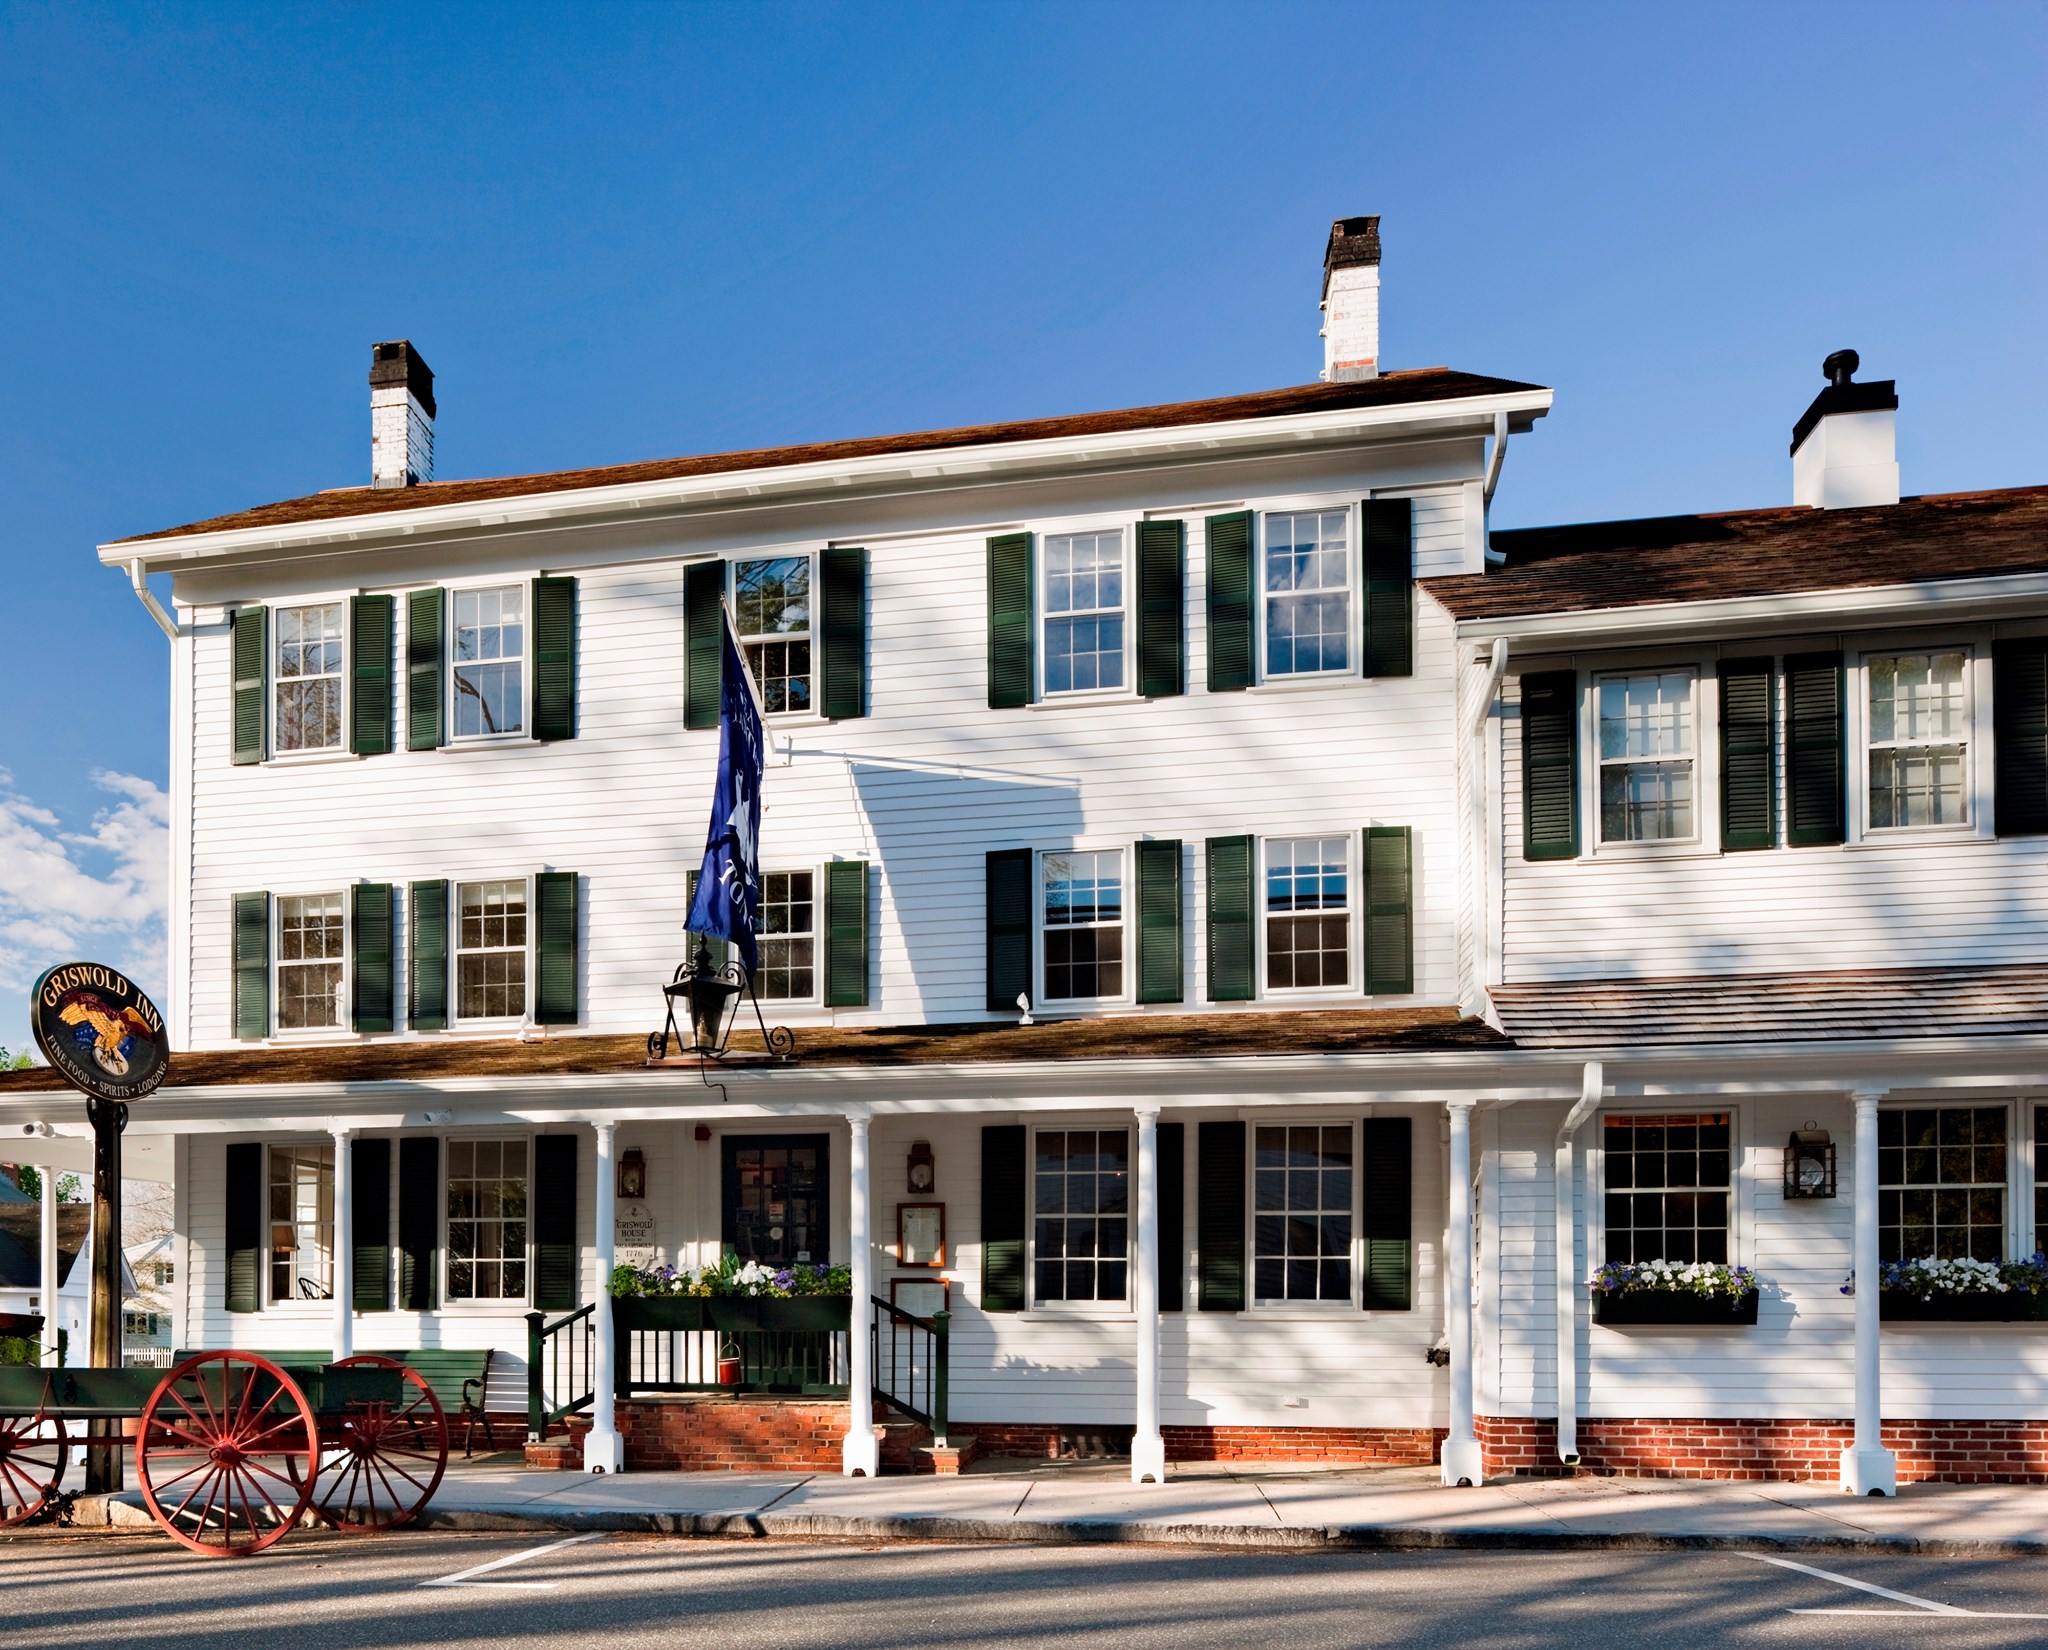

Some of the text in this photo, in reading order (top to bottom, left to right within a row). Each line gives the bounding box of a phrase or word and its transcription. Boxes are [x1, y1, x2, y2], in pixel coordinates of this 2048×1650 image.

[43, 966, 163, 1033] GRISWOLD INN
[47, 1034, 167, 1097] FINE FOOD SPIRITS LODGING
[616, 1221, 653, 1229] GRISWOLD
[621, 1229, 647, 1237] HOUSE
